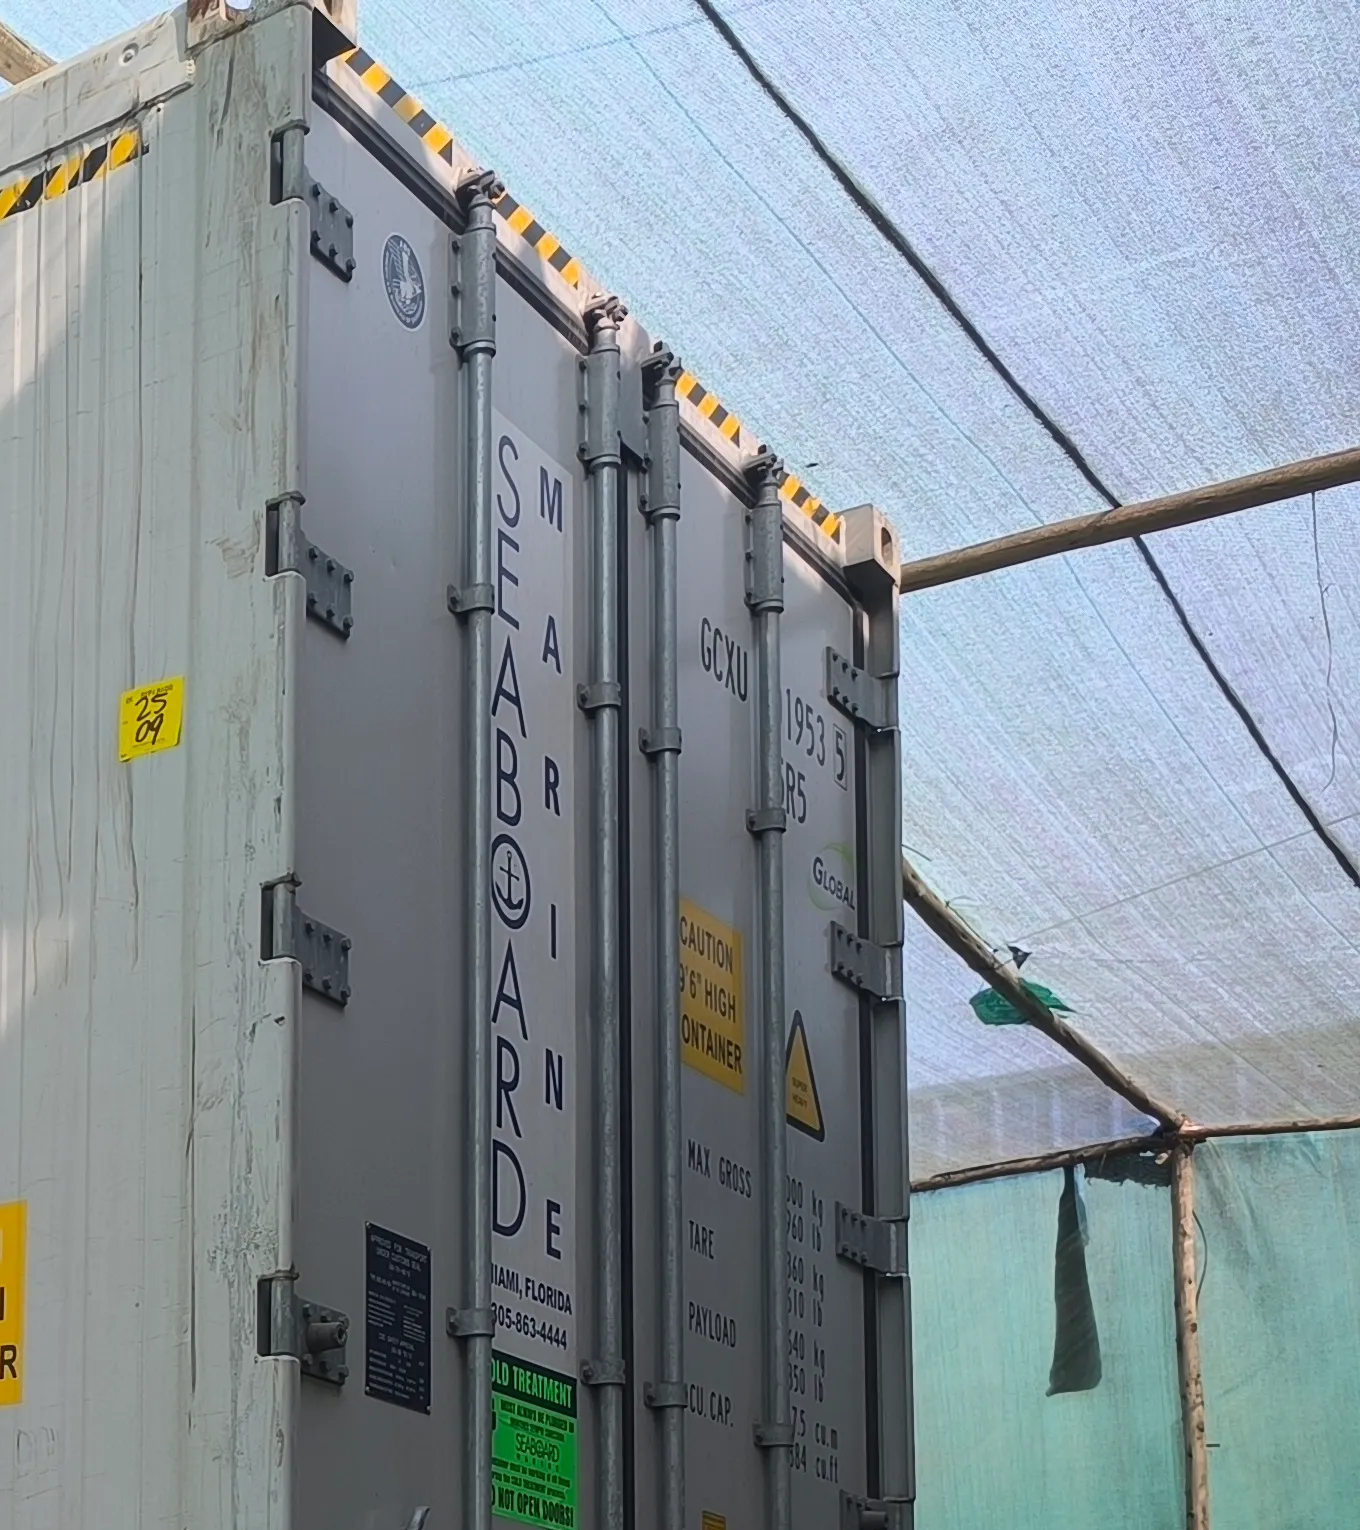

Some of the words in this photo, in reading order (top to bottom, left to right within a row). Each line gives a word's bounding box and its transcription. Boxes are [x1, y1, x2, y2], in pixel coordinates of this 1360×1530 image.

[135, 692, 168, 722] 25
[701, 617, 748, 702] GCXU
[786, 688, 826, 767] 1953
[835, 730, 845, 781] 5
[135, 713, 164, 745] 09
[491, 435, 530, 1237] SEABOARD
[540, 465, 563, 1259] MARINE
[680, 915, 733, 975] CAUTION
[705, 978, 736, 1024] HIGH
[681, 1013, 743, 1074] ONTAINER
[688, 1138, 711, 1179] MAX
[719, 1156, 752, 1199] GROSS
[786, 1175, 803, 1208] 000
[812, 1189, 823, 1228] kg
[689, 1220, 714, 1260] TARE
[786, 1251, 804, 1284] 360
[813, 1264, 824, 1302] kg
[812, 1222, 821, 1252] lb
[525, 1277, 572, 1316] FLORIDA
[813, 1298, 822, 1327] lb
[491, 1302, 567, 1350] 305-863-4444
[689, 1301, 737, 1348] PAYLOAD
[814, 1339, 825, 1378] kg
[491, 1357, 510, 1387] OLD
[512, 1365, 572, 1409] TREATMENT
[814, 1374, 824, 1403] lb
[791, 1406, 806, 1437] 7.5
[498, 1486, 515, 1511] NOT
[517, 1492, 540, 1518] OPEN
[542, 1499, 574, 1528] DOORS!
